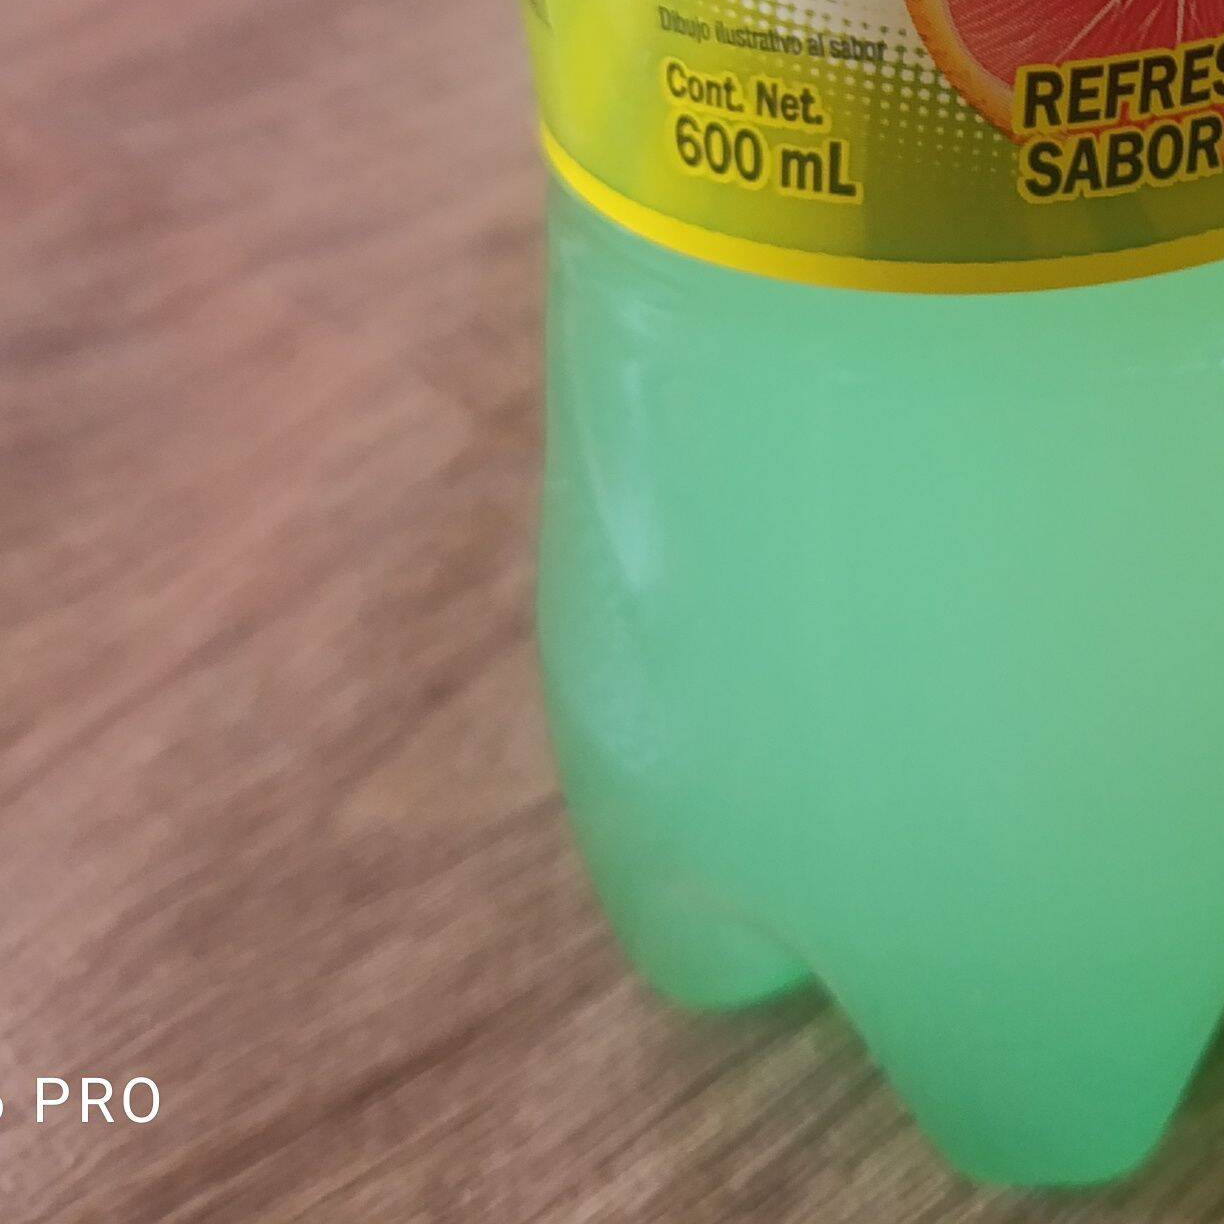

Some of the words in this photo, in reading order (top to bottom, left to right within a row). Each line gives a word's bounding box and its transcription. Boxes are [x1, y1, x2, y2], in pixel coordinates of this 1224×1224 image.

[658, 6, 711, 44] Dibujo
[714, 20, 803, 55] ilustrativo
[807, 32, 824, 57] al
[829, 37, 888, 61] sabor
[665, 62, 745, 113] Cont.
[756, 80, 824, 125] Net.
[674, 113, 763, 182] 600
[780, 141, 857, 197] mL
[1024, 115, 1223, 197] SABOR
